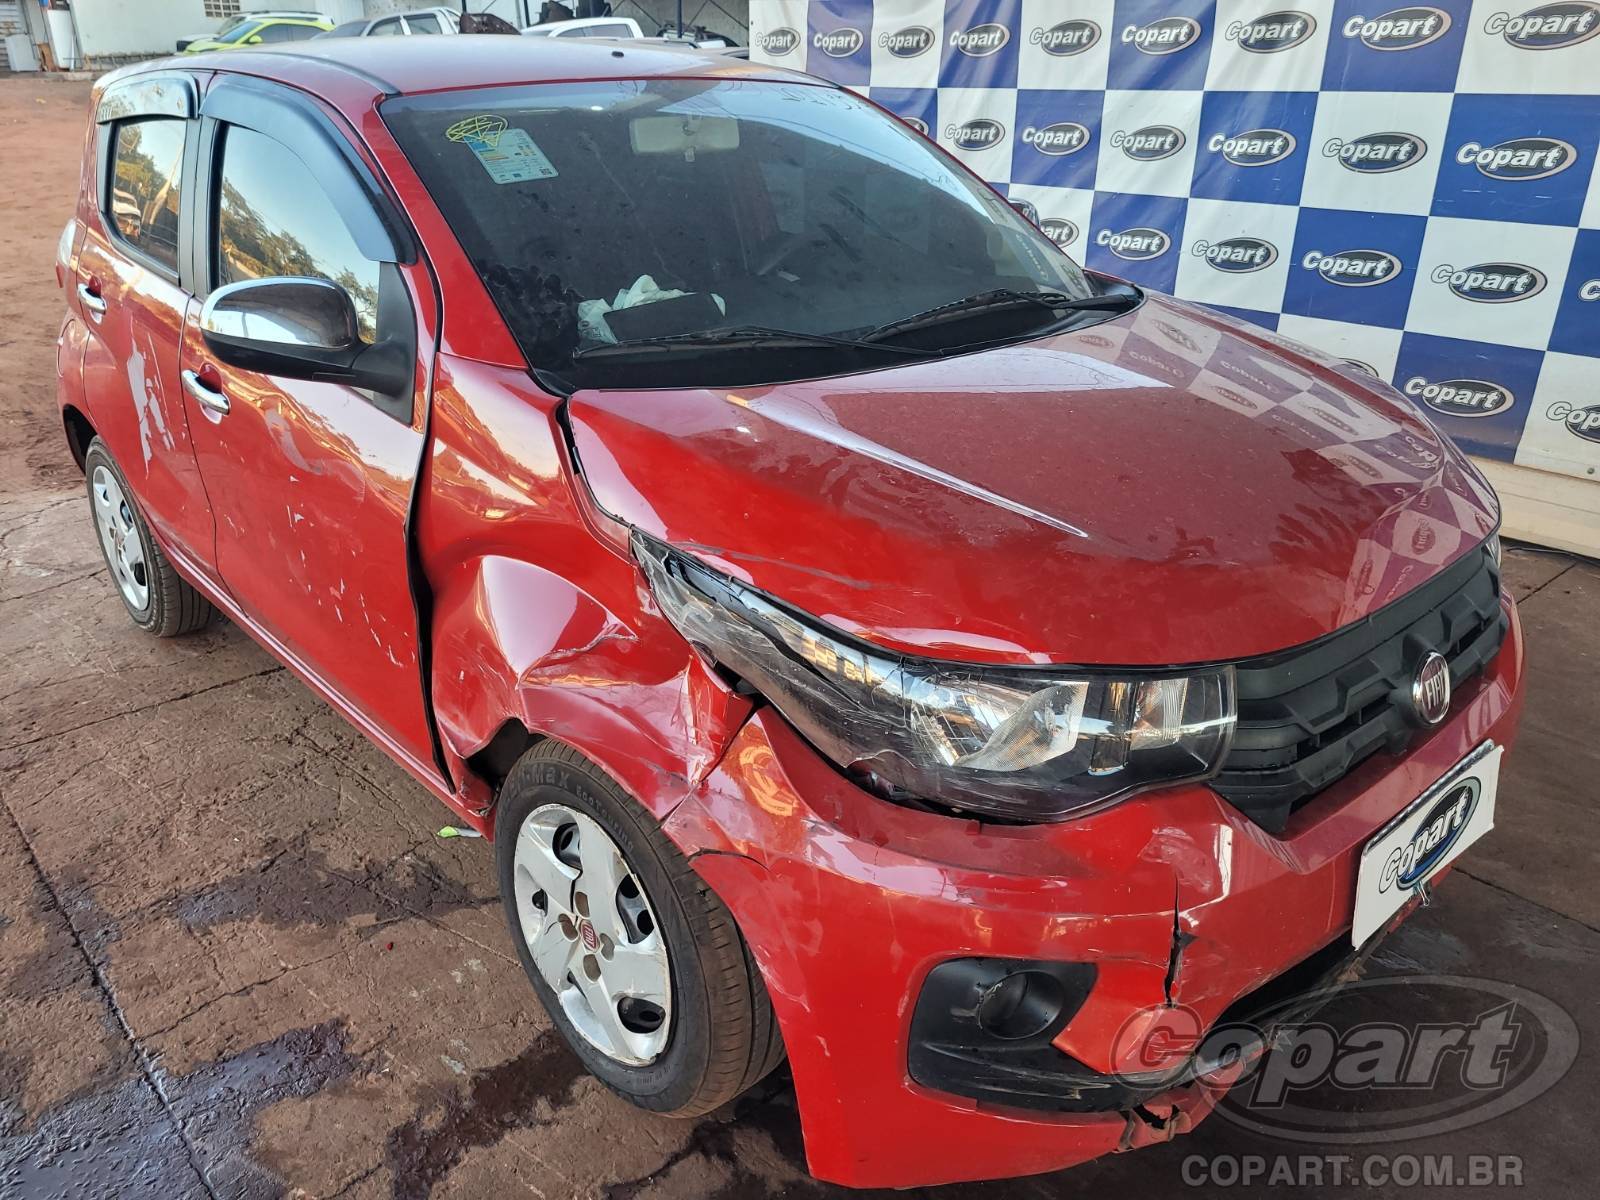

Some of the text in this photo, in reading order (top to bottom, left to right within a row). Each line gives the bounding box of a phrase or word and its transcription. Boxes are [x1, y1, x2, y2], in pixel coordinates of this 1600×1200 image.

[949, 25, 1001, 50] Copart
[1029, 25, 1093, 47] Copart
[1122, 23, 1192, 45] Copart
[1225, 15, 1303, 44] Copart
[1343, 11, 1439, 42] Copart
[1484, 9, 1597, 41] Copart
[755, 29, 792, 50] Copart
[813, 28, 858, 51] Copart
[878, 28, 925, 52] Copart
[945, 124, 998, 145] Copart
[1022, 127, 1082, 147] Copart
[1110, 130, 1177, 154] Copart
[1208, 134, 1285, 158] Copart
[1322, 137, 1414, 163] Copart
[1456, 142, 1564, 171] Copart
[1041, 225, 1070, 245] art
[1096, 229, 1161, 253] Copart
[1192, 239, 1268, 264] Copart
[1302, 250, 1391, 278] Copart
[1431, 264, 1534, 294] Copart
[1404, 377, 1499, 409] Copart
[1424, 670, 1447, 711] FIAT
[1379, 786, 1470, 893] Copart
